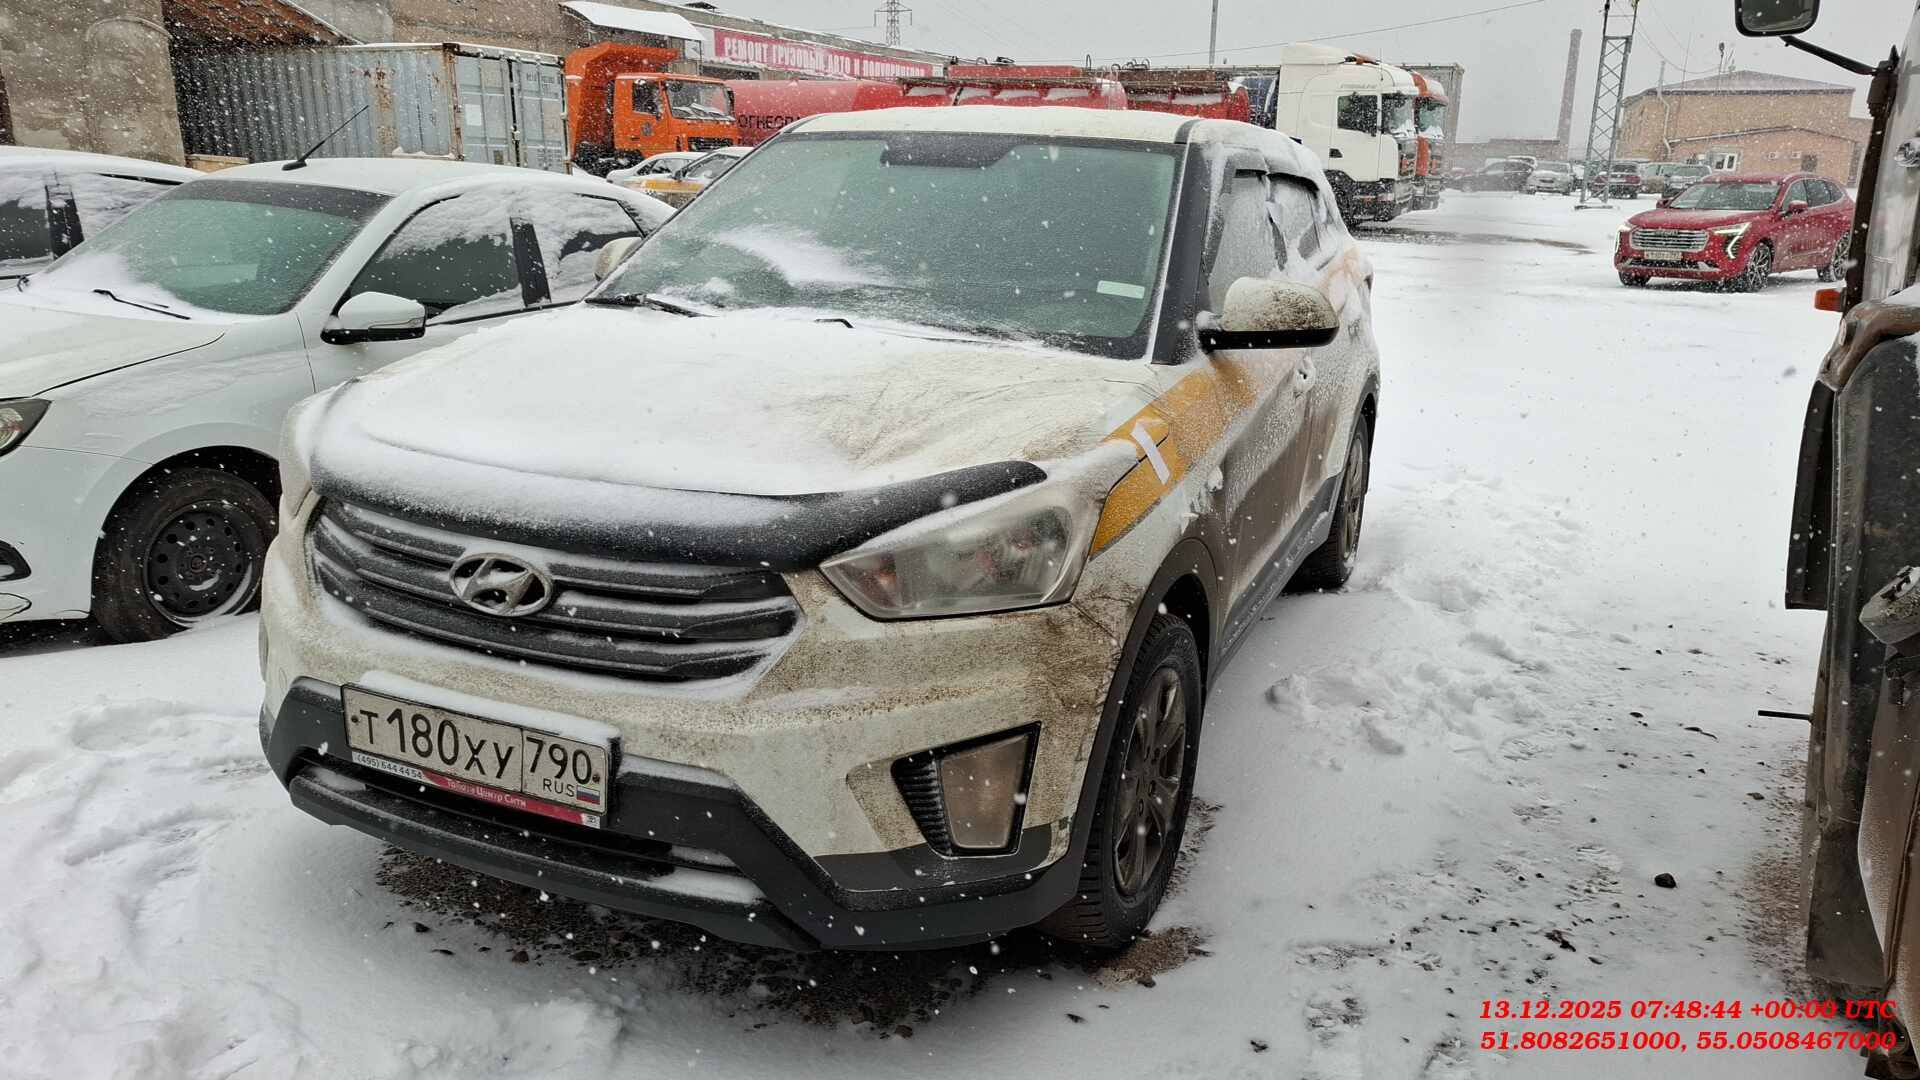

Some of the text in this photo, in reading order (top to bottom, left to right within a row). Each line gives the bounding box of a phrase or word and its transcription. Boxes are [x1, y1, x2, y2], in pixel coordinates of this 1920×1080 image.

[724, 37, 768, 62] РЕМОНТ
[828, 54, 850, 75] АВТО
[526, 736, 592, 785] 790
[542, 778, 575, 797] RUS
